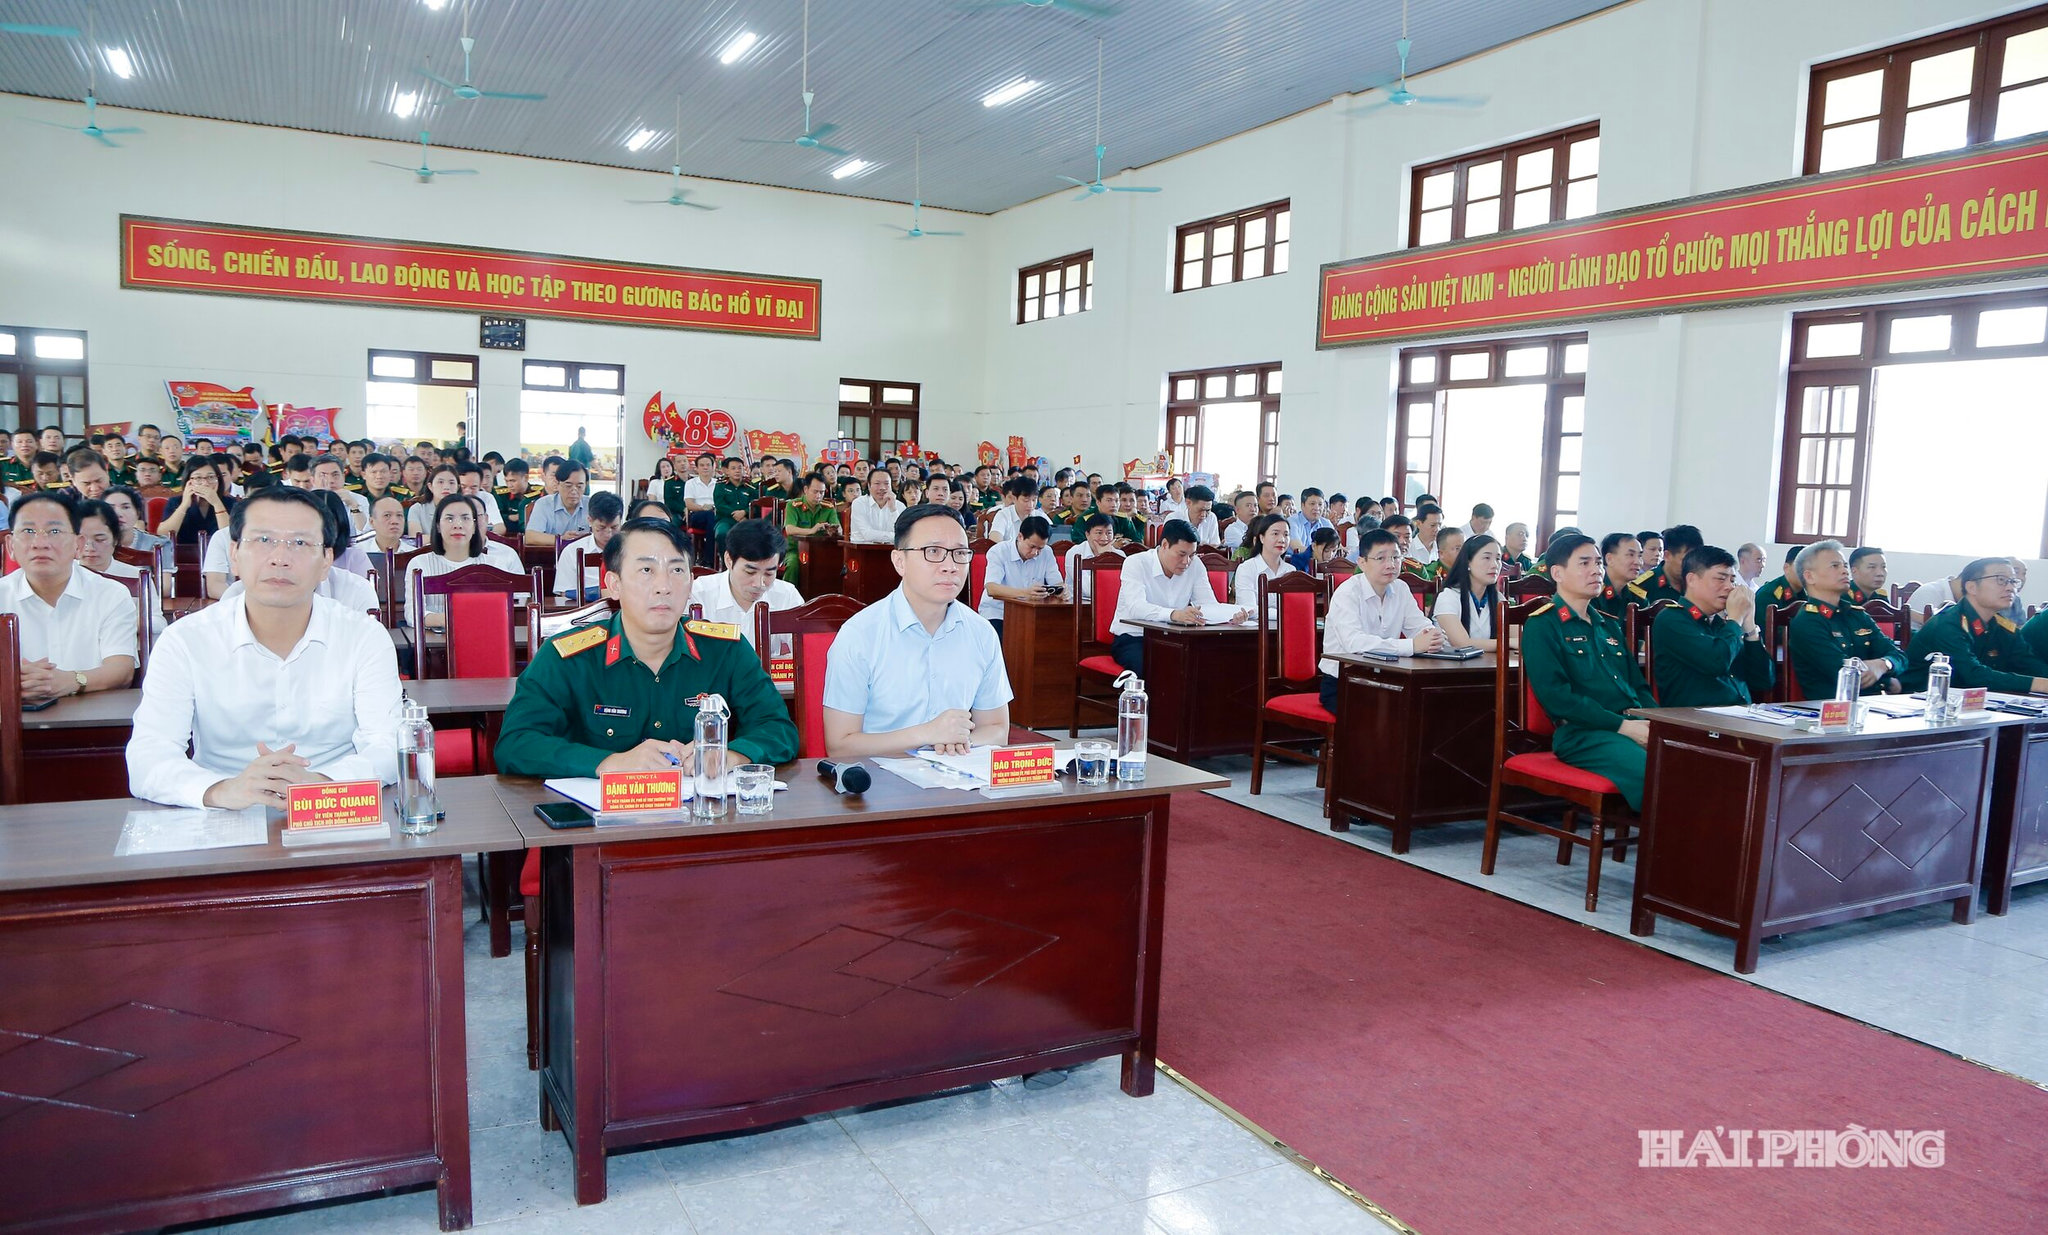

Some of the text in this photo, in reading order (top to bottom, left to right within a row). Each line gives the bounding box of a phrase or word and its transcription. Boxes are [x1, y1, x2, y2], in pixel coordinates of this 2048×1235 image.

[1332, 286, 1362, 320] ĐẢNG
[1365, 284, 1398, 321] CỘNG
[1401, 275, 1427, 312] SẢN
[1431, 273, 1459, 312] VIỆT
[1461, 272, 1494, 303] NAM
[1508, 257, 1555, 297] NGƯỜI
[1558, 253, 1601, 291] LÃNH
[1606, 250, 1640, 289] ĐẠO
[1646, 232, 1669, 279] TỔ
[1673, 232, 1724, 275] CHỨC
[1730, 230, 1770, 274] MỌI
[1776, 209, 1849, 262] THẮNG
[1855, 210, 1893, 259] LỢI
[1900, 193, 1951, 247] CỦA
[1960, 188, 2037, 239] CÁCH
[148, 240, 803, 322] SỐNG, CHIẾN ĐẤU, LAO ĐỘNG VÀ HỌC TẬP THEO GƯƠNG BÁC HỒ VĨ ĐẠI
[683, 409, 736, 449] 80
[994, 756, 1052, 770] ĐÀO TRỌNG ĐỨC
[606, 782, 676, 797] ĐẶNG VĂN THƯƠNG
[294, 796, 376, 811] BÙI ĐỨC QUANG
